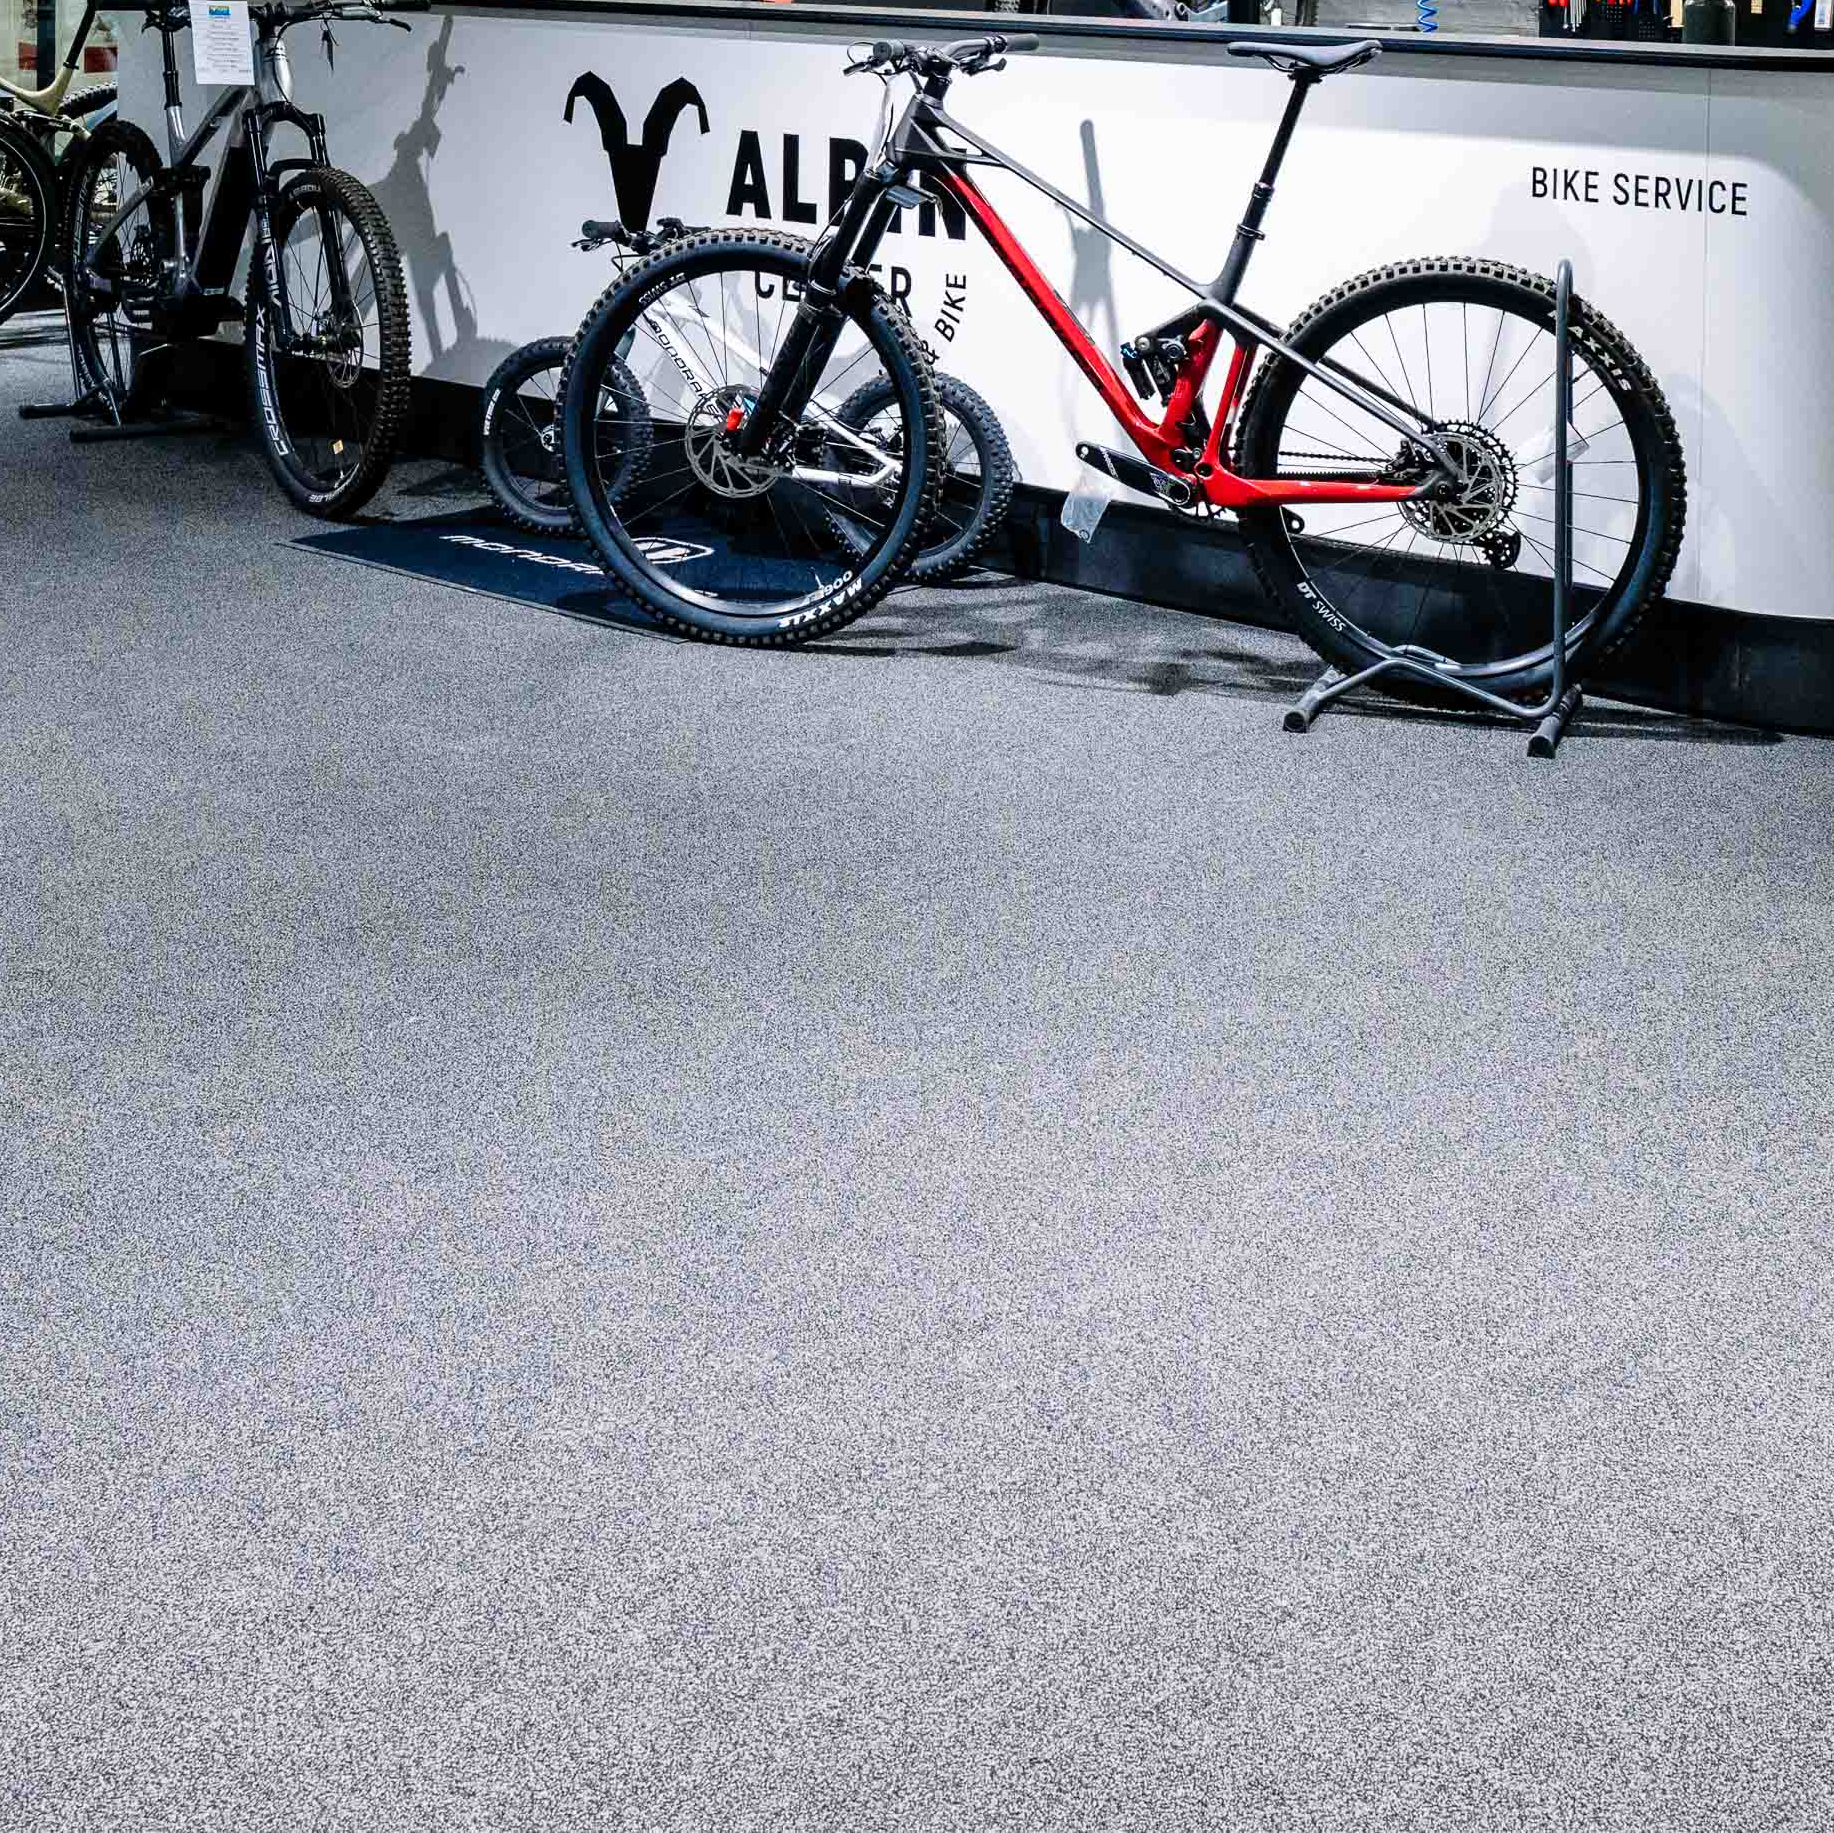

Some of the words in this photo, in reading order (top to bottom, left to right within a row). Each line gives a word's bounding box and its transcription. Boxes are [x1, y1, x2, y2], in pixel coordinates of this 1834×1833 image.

[1532, 166, 1600, 203] BIKE
[1613, 172, 1748, 216] SERVICE
[934, 273, 967, 342] BIKE
[255, 303, 289, 457] CROSSMAX
[775, 577, 862, 628] MAXXIS
[1297, 581, 1317, 599] DT
[1312, 600, 1347, 633] SWISS
